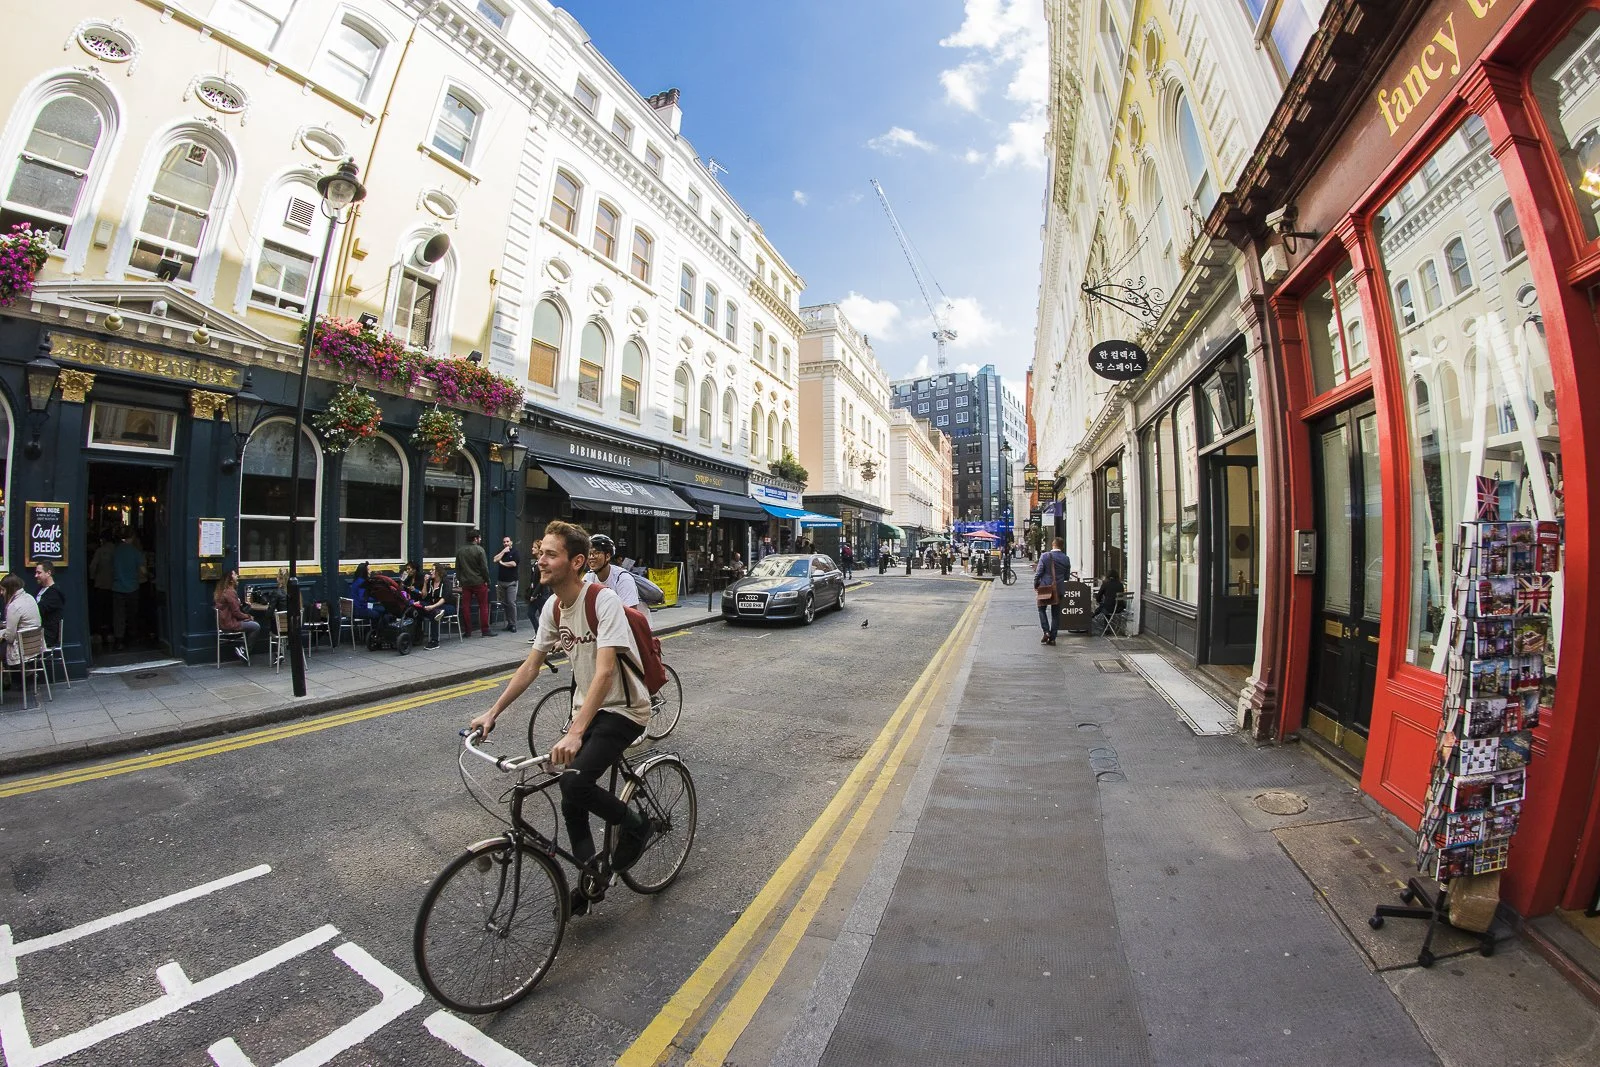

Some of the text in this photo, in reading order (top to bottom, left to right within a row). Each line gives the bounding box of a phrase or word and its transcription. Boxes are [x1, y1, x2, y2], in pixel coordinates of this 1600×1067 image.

[1377, 12, 1460, 136] fancy
[1098, 350, 1108, 359] 한
[1106, 362, 1142, 372] 스페이스
[32, 523, 62, 541] Craft
[33, 541, 60, 552] BEERS
[1061, 607, 1083, 615] CHIPS
